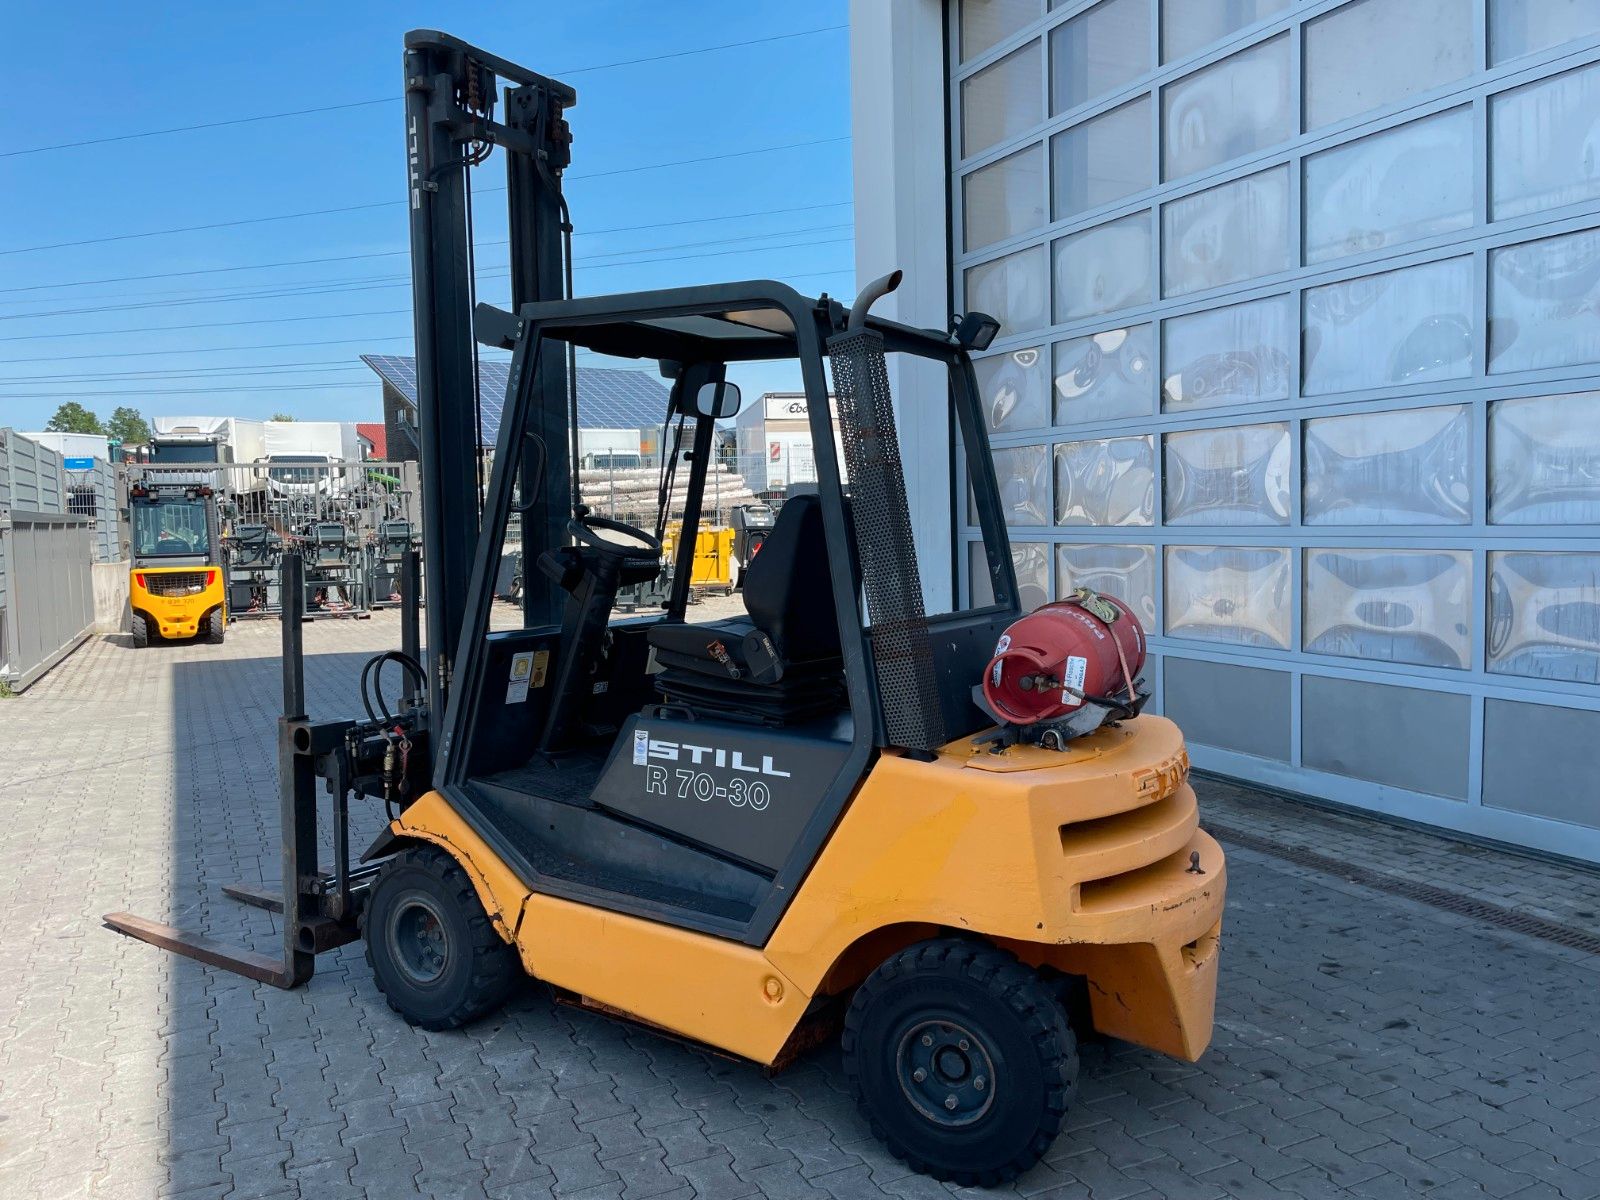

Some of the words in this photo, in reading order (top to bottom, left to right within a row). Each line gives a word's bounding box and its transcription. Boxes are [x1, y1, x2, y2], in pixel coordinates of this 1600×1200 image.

[408, 116, 420, 209] STILL
[648, 739, 791, 778] STILL
[646, 764, 668, 796] R
[676, 768, 770, 811] 70-30
